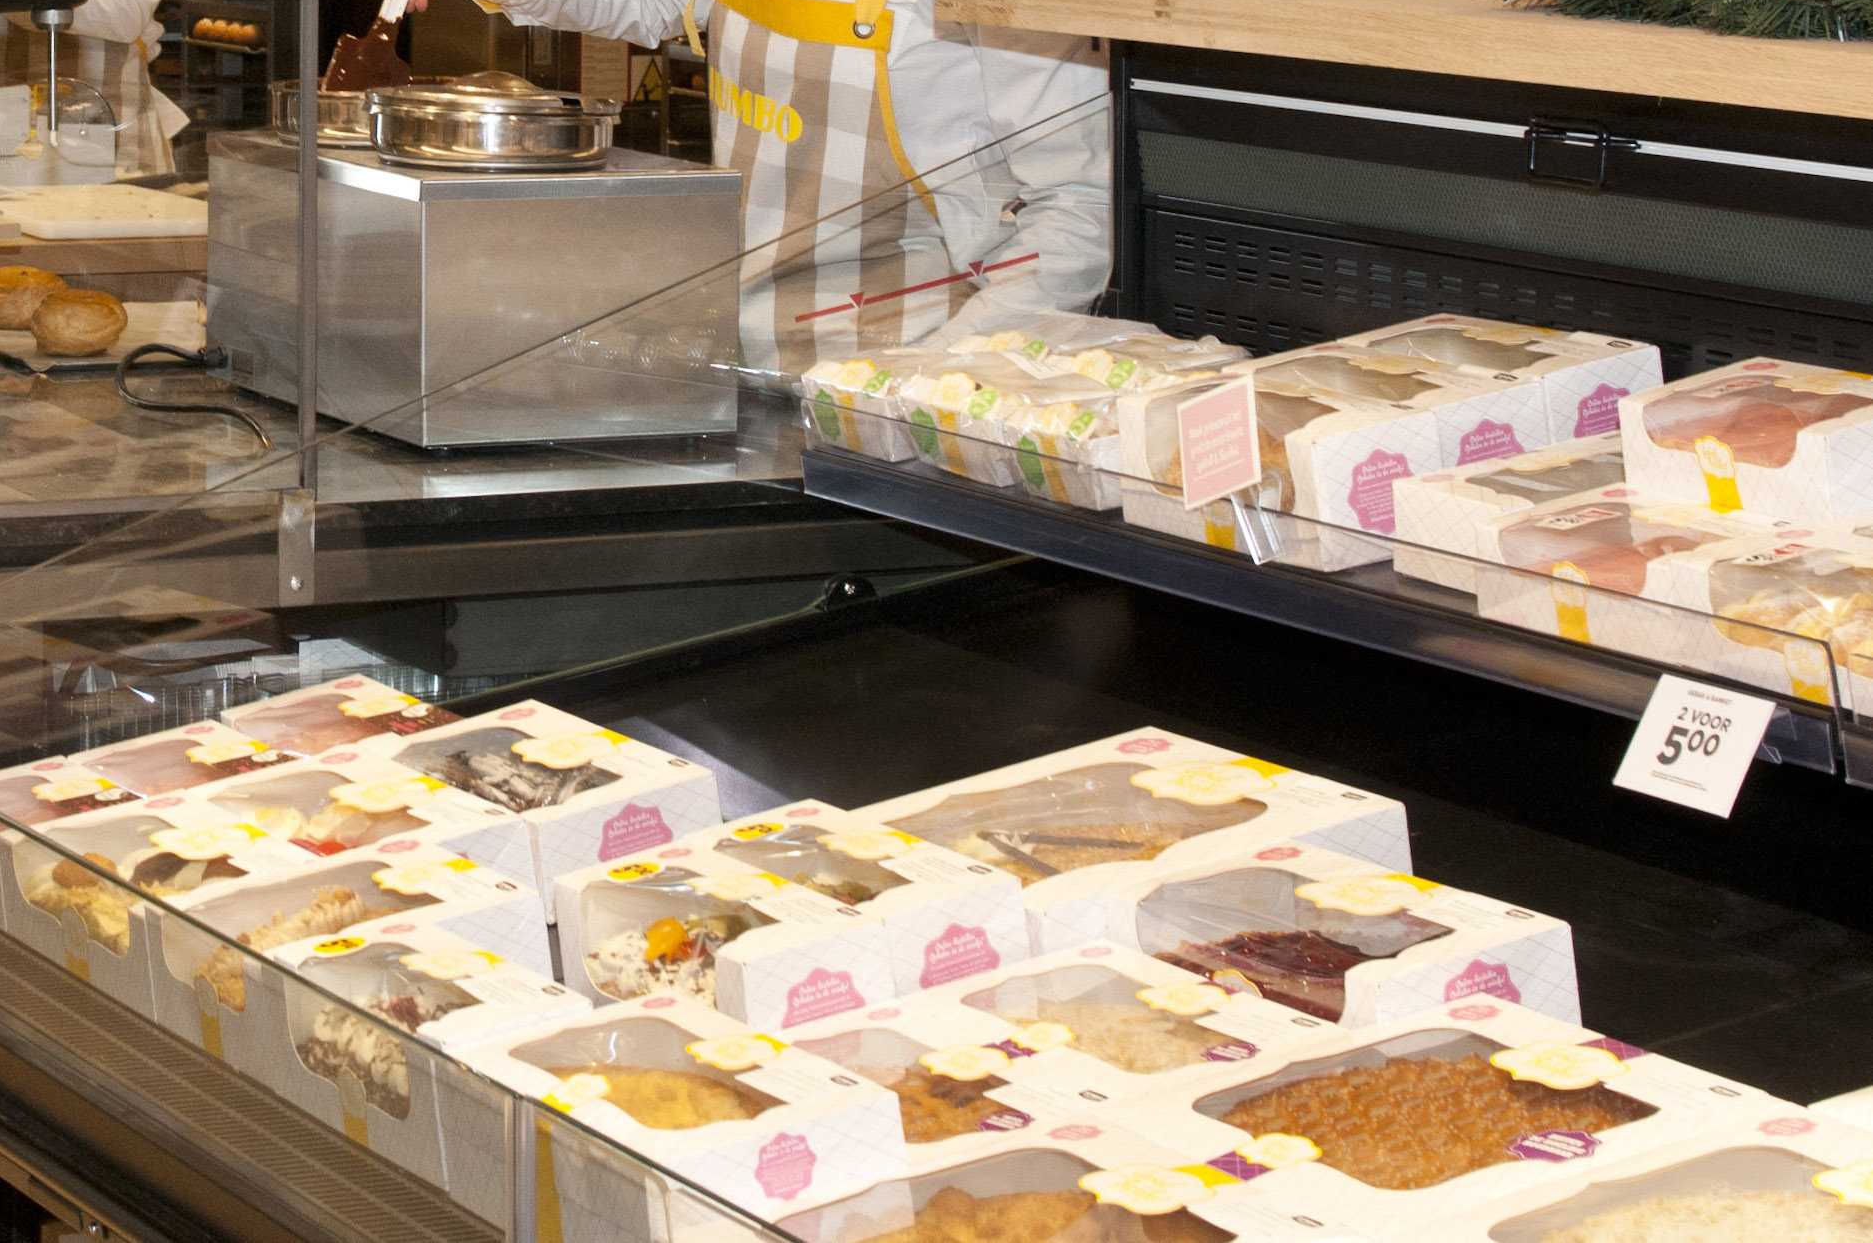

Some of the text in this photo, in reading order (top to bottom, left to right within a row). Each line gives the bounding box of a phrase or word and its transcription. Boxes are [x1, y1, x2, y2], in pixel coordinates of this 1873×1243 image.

[710, 66, 803, 142] JUMBO
[1677, 706, 1732, 733] 2 VOOR
